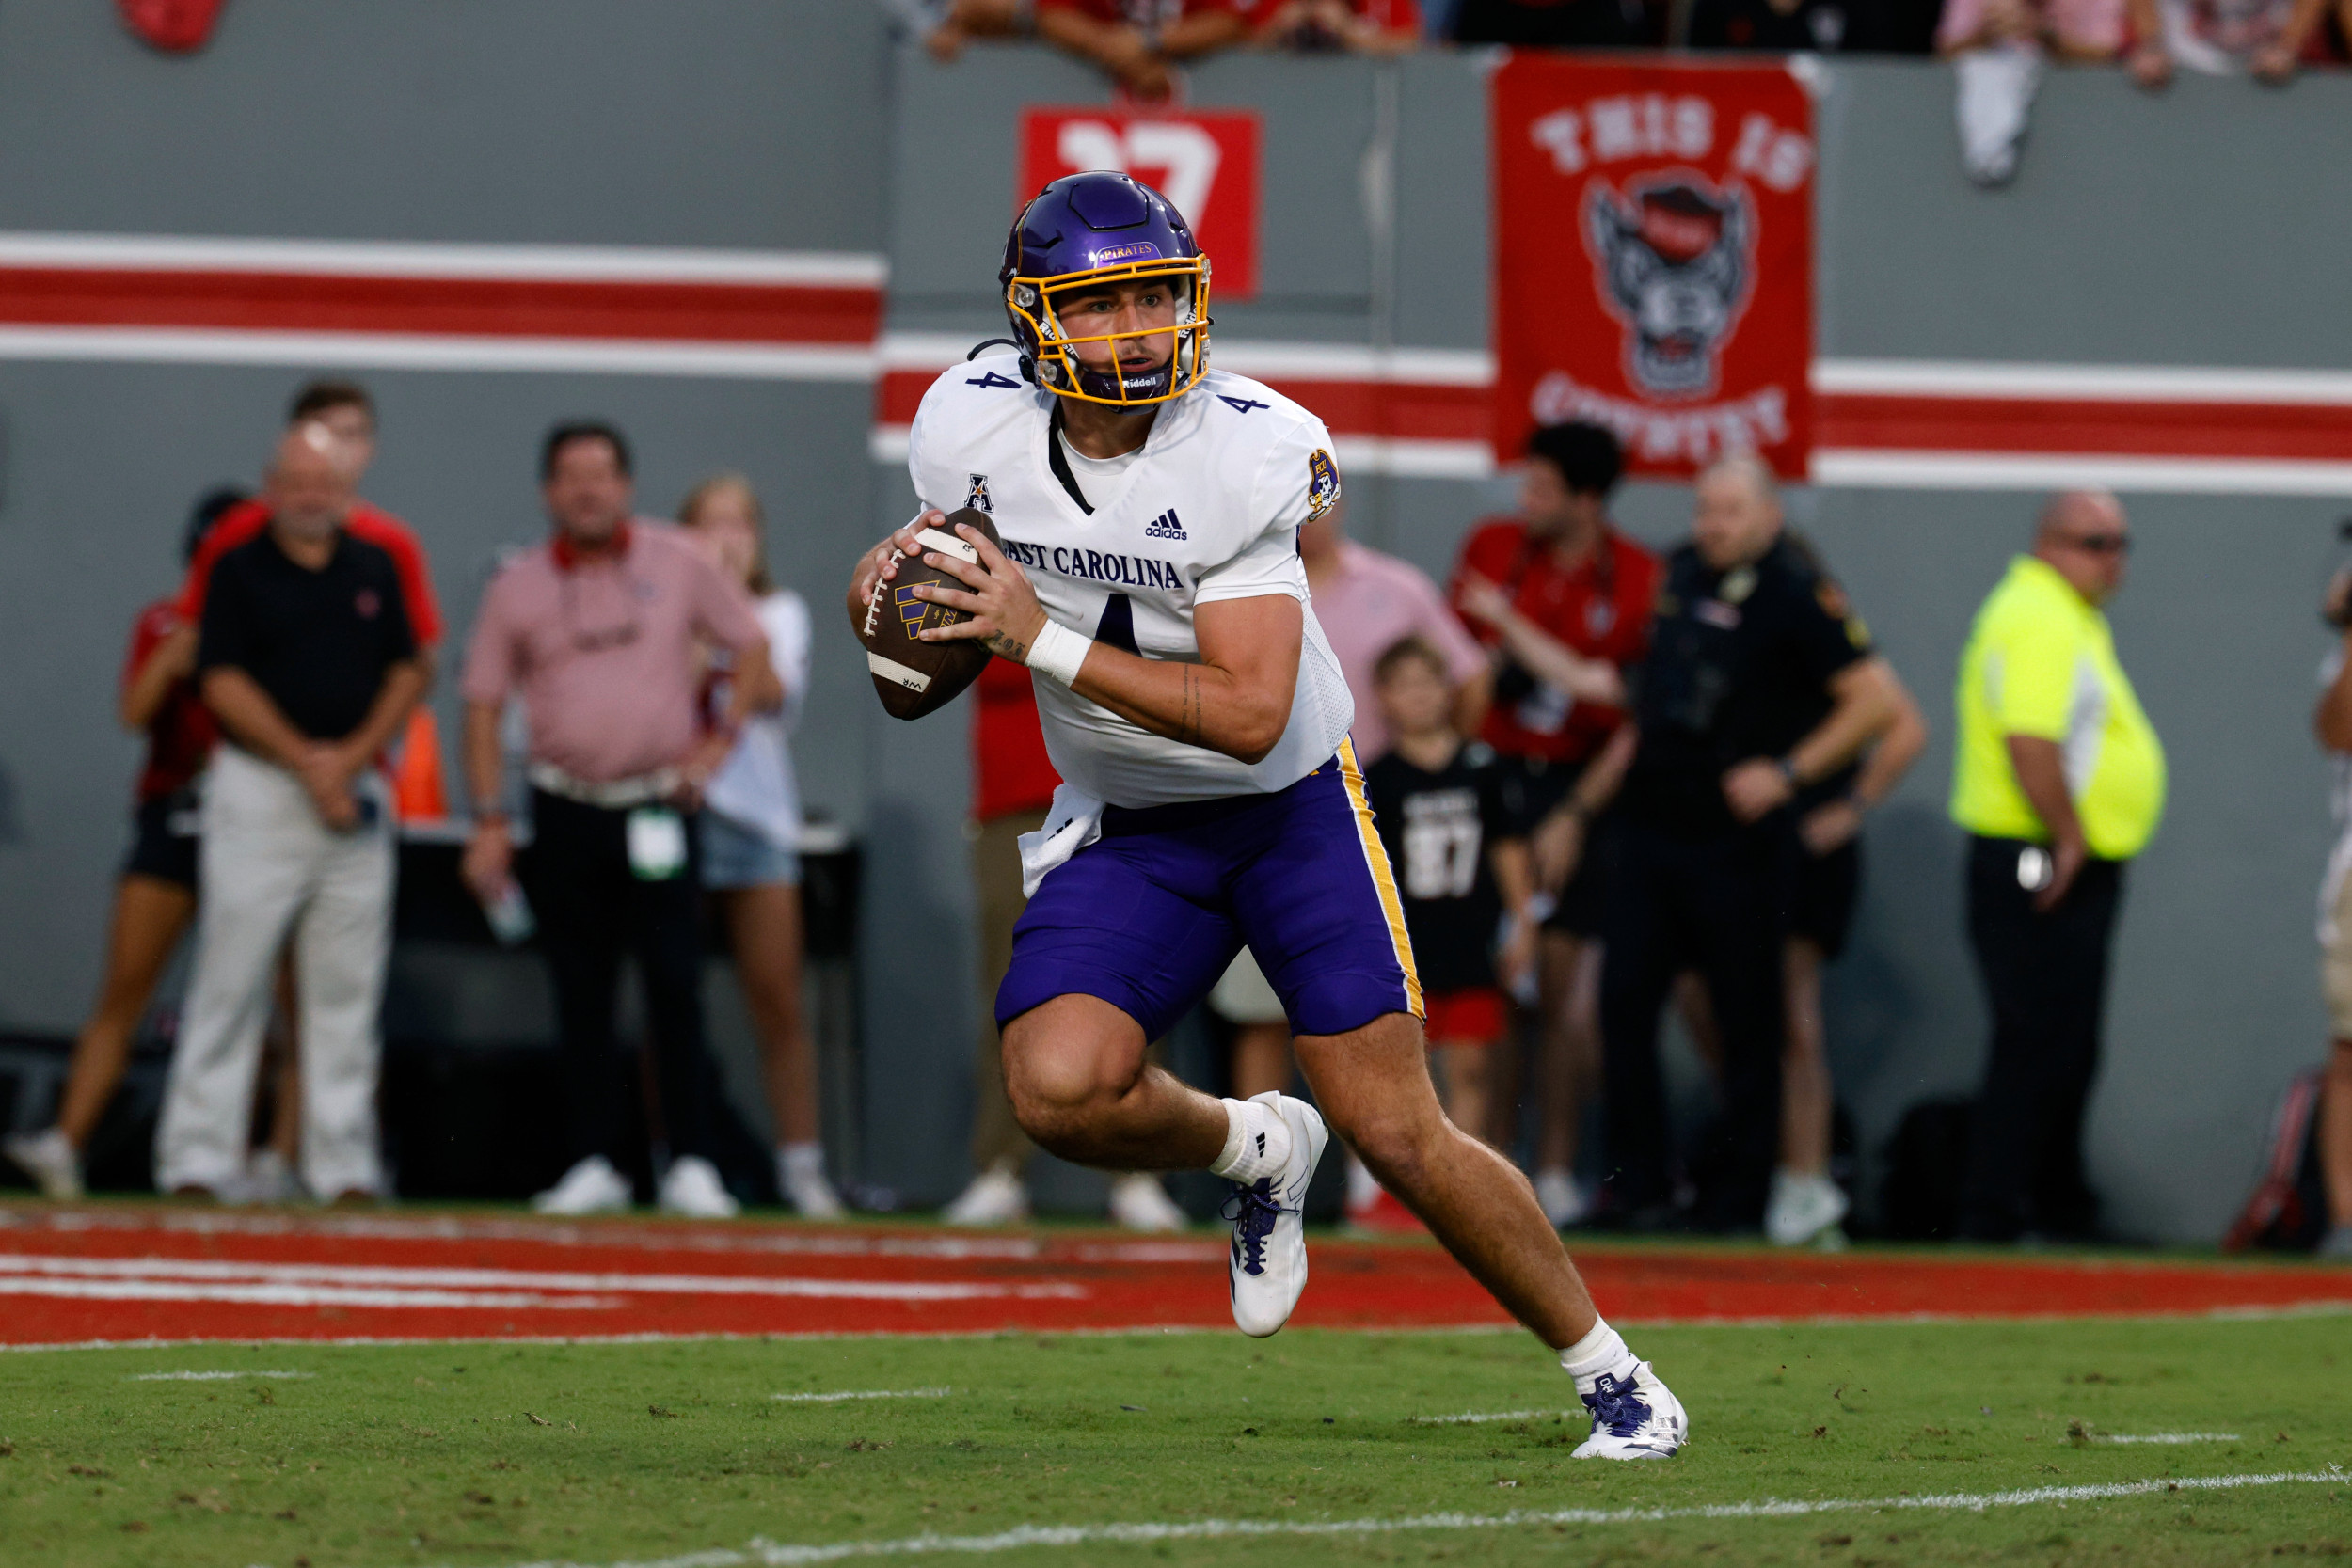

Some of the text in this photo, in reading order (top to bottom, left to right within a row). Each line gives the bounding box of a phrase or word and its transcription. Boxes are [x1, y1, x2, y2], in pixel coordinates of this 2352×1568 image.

[1533, 94, 1814, 191] THIS IS
[1104, 245, 1152, 260] PIRATES
[965, 371, 1023, 389] 4
[1123, 376, 1157, 388] Riddell
[1216, 394, 1271, 414] 4
[1145, 526, 1188, 541] adidas
[1003, 539, 1184, 591] AST CAROLINA
